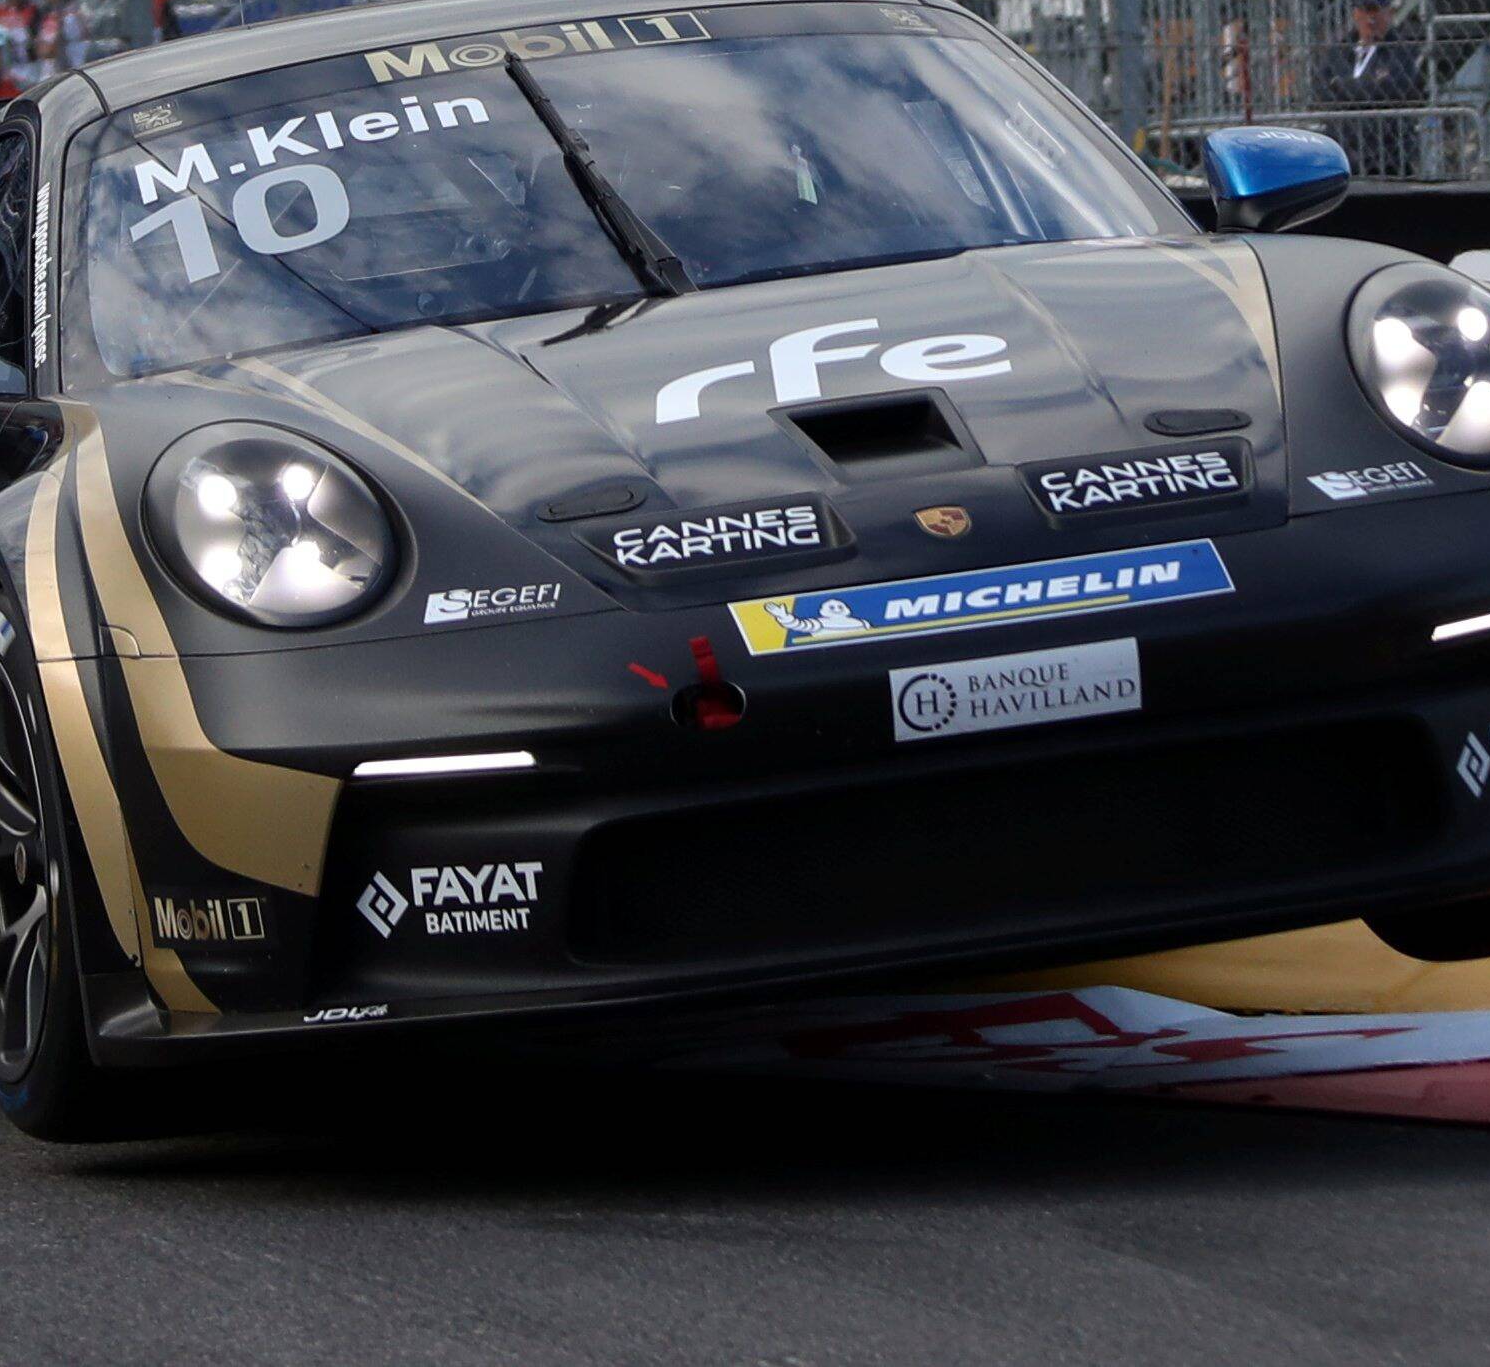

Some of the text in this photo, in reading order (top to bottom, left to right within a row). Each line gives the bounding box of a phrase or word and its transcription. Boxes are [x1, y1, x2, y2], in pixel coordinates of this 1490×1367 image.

[364, 20, 616, 83] Mobil
[134, 96, 490, 205] M.Klein
[129, 164, 350, 283] 10
[1040, 451, 1228, 491] CANNES
[1048, 468, 1239, 512] KARTING
[613, 505, 817, 547] CANNES
[616, 524, 821, 566] KARTING
[884, 561, 1181, 620] MICHELIN
[967, 662, 1070, 694] BANQUE
[970, 678, 1137, 719] HAVILLAND
[410, 861, 544, 907] FAYAT
[154, 897, 227, 941] Mobil
[424, 908, 531, 934] BATIMENT
